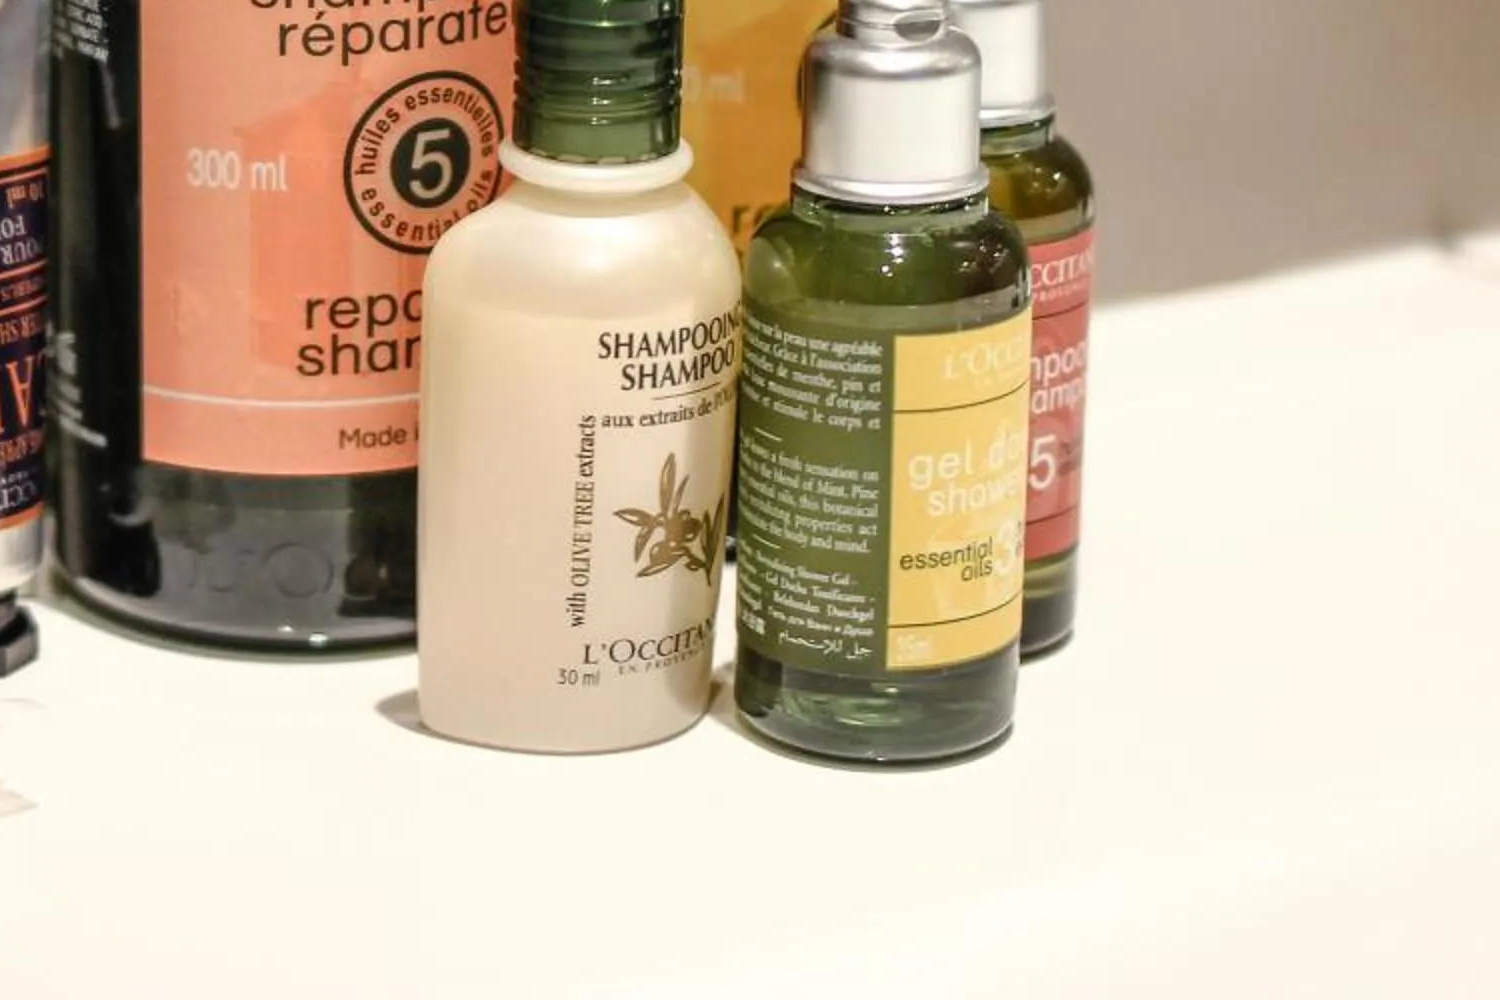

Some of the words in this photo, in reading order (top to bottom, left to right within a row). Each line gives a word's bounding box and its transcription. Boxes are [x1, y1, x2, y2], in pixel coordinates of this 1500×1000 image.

[278, 0, 514, 66] réparate
[354, 106, 401, 176] huiles
[403, 85, 495, 158] essentielles
[186, 148, 241, 191] 300
[250, 151, 289, 191] ml
[407, 127, 453, 200] 5
[0, 236, 39, 266] OUR
[620, 338, 735, 392] SHAMPOO
[600, 413, 635, 429] aux
[638, 403, 695, 428] extraits
[697, 396, 712, 418] de
[338, 425, 408, 450] Made
[578, 413, 598, 479] extracts
[1028, 431, 1058, 492] 5
[908, 438, 975, 491] gel
[573, 481, 595, 528] TREE
[570, 529, 593, 595] OLIVE
[899, 534, 994, 571] essential
[961, 557, 994, 583] oils
[565, 597, 587, 629] with
[582, 617, 714, 666] L'OCCITAN
[556, 666, 579, 687] 30
[582, 666, 601, 688] ml
